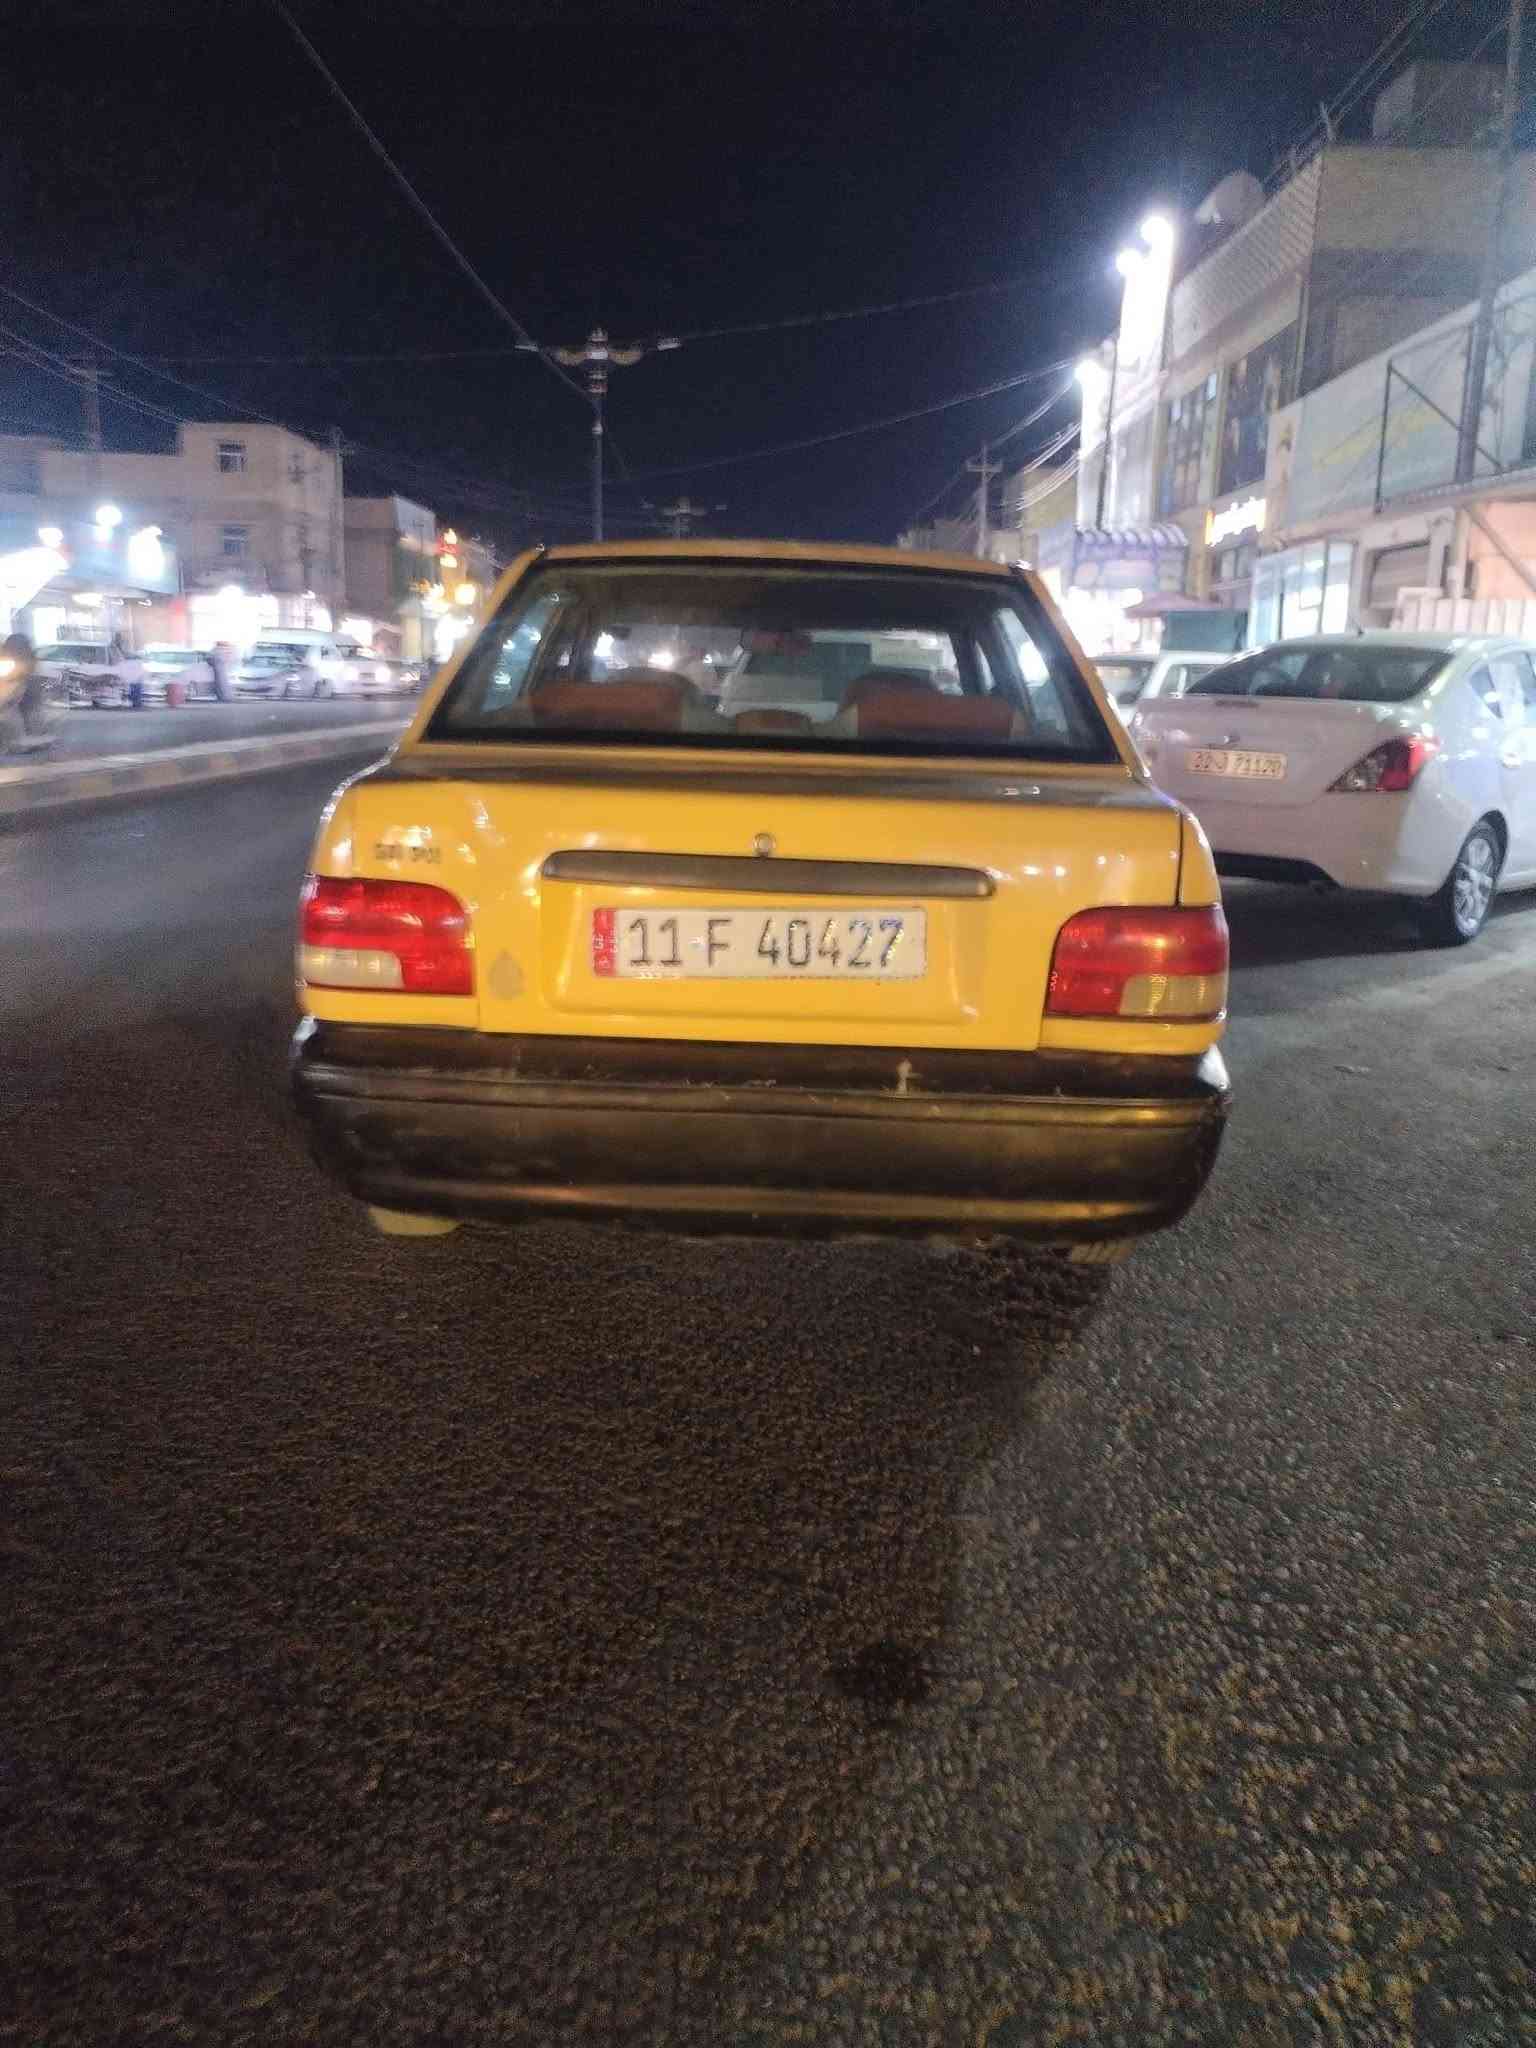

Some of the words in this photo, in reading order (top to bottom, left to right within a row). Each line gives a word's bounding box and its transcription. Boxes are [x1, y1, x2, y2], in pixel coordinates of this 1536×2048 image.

[629, 917, 682, 967] 11
[706, 918, 734, 967] F
[757, 917, 903, 967] 40427
